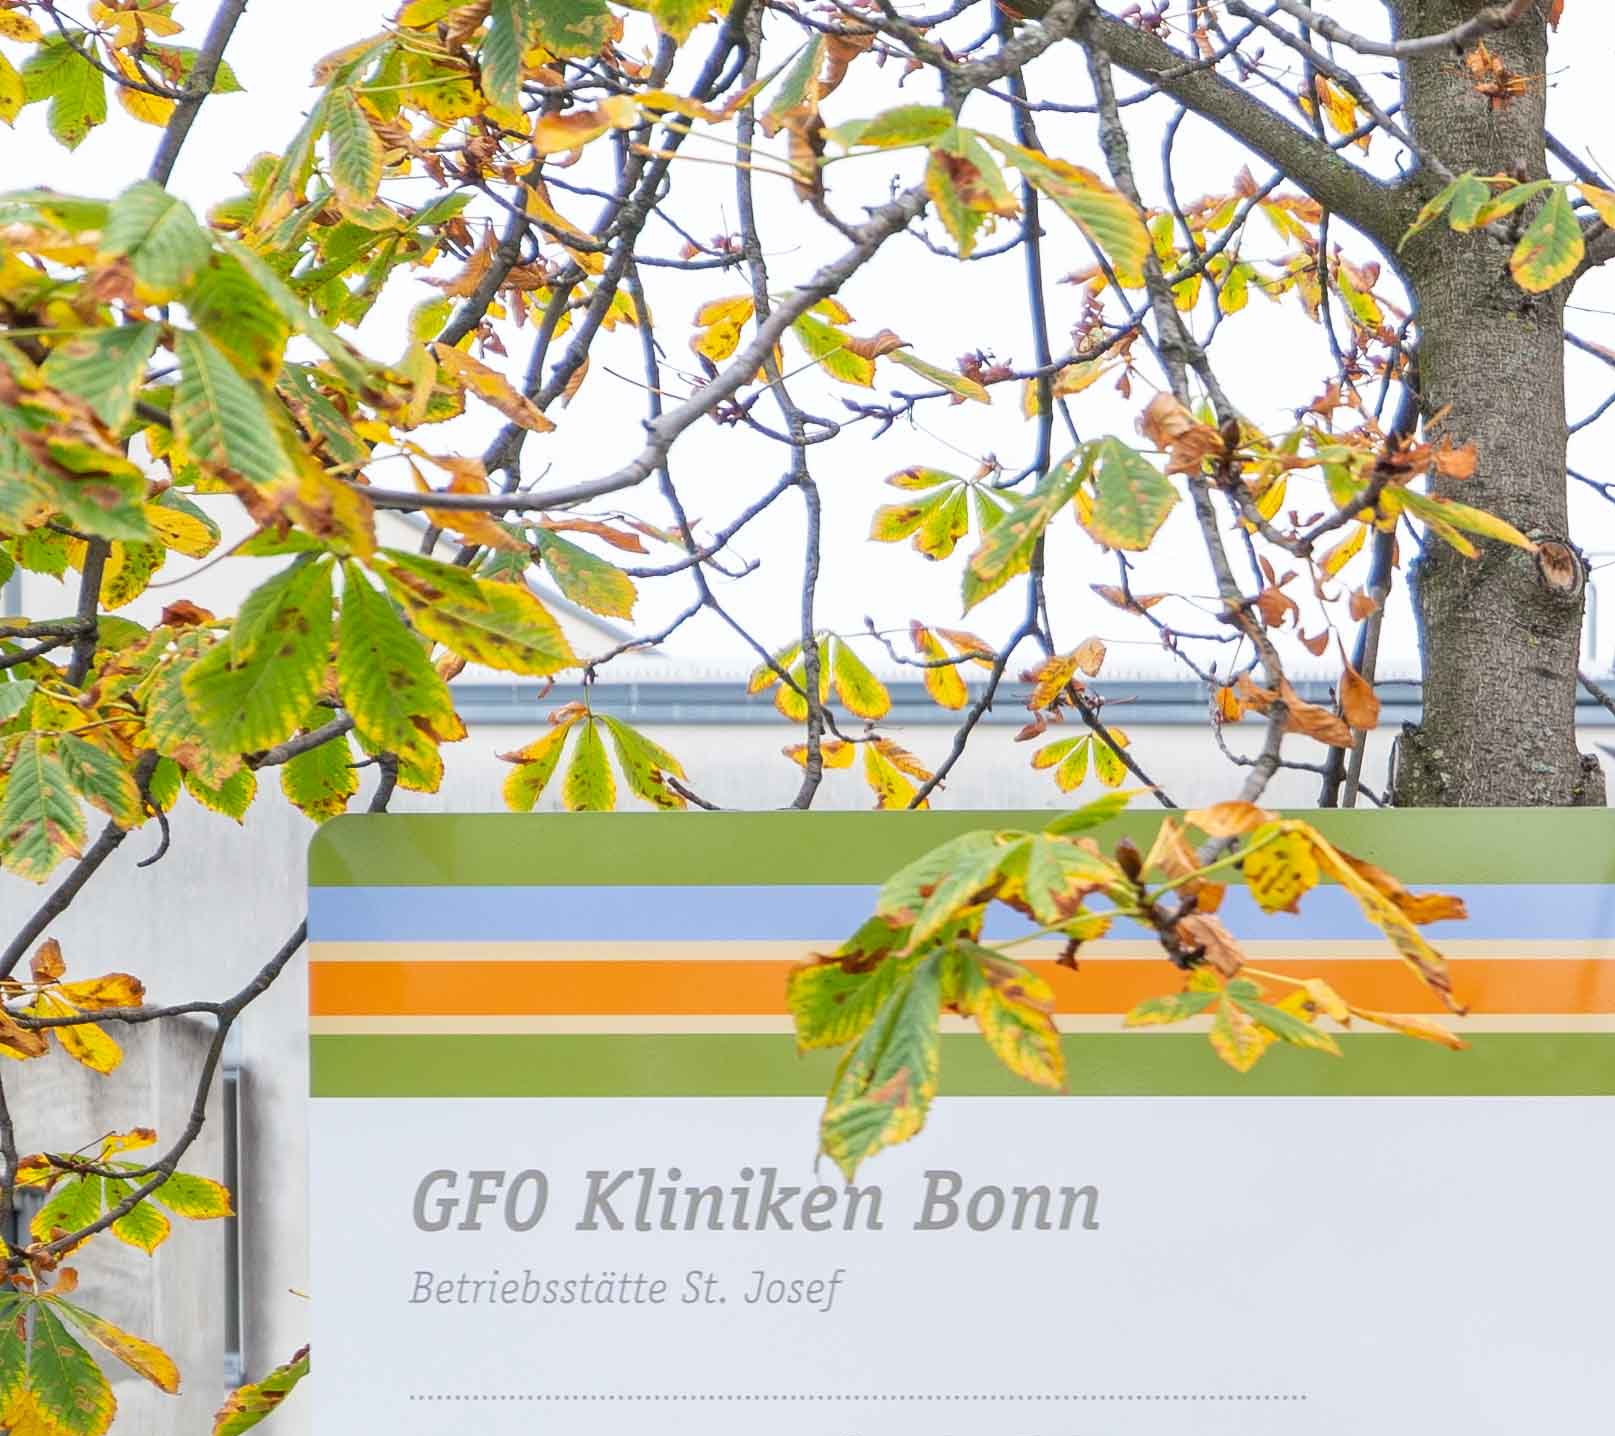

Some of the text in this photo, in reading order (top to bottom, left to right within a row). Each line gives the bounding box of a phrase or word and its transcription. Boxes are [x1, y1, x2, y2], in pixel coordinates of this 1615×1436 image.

[412, 1166, 1100, 1233] GFO Kliniken Bonn
[407, 1268, 847, 1313] Betriebsstätte St. Josef
